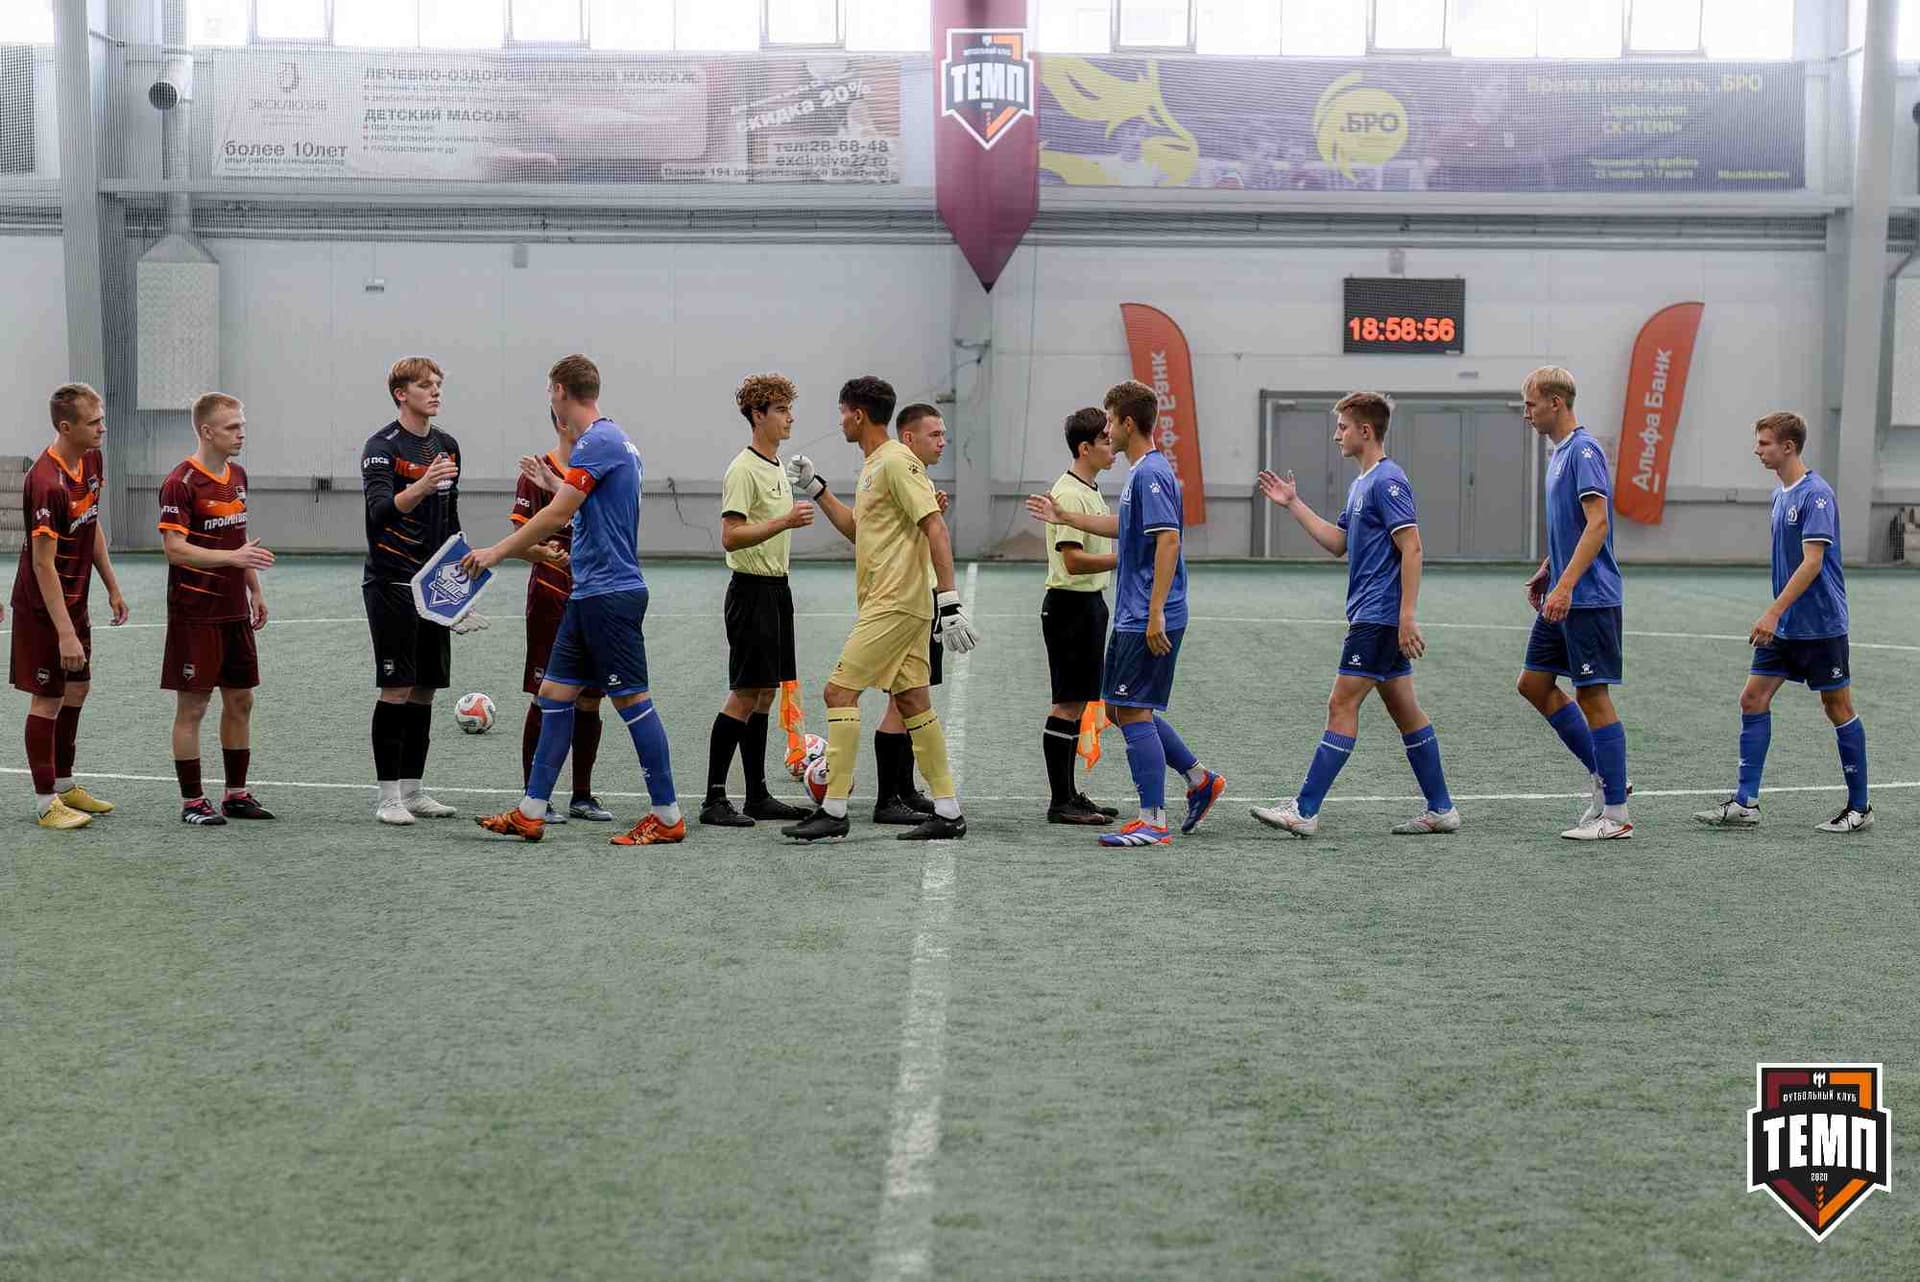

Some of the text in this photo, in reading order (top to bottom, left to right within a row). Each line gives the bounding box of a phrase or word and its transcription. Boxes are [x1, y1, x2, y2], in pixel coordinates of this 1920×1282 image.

[819, 78, 872, 108] 20%
[950, 61, 1025, 104] ТЕМП
[364, 107, 441, 123] ДЕТСКИЙ
[1340, 111, 1400, 134] .БРО
[225, 140, 349, 158] более 10лет
[1349, 317, 1456, 342] 18:58:56
[1631, 348, 1674, 492] Альфа Банк
